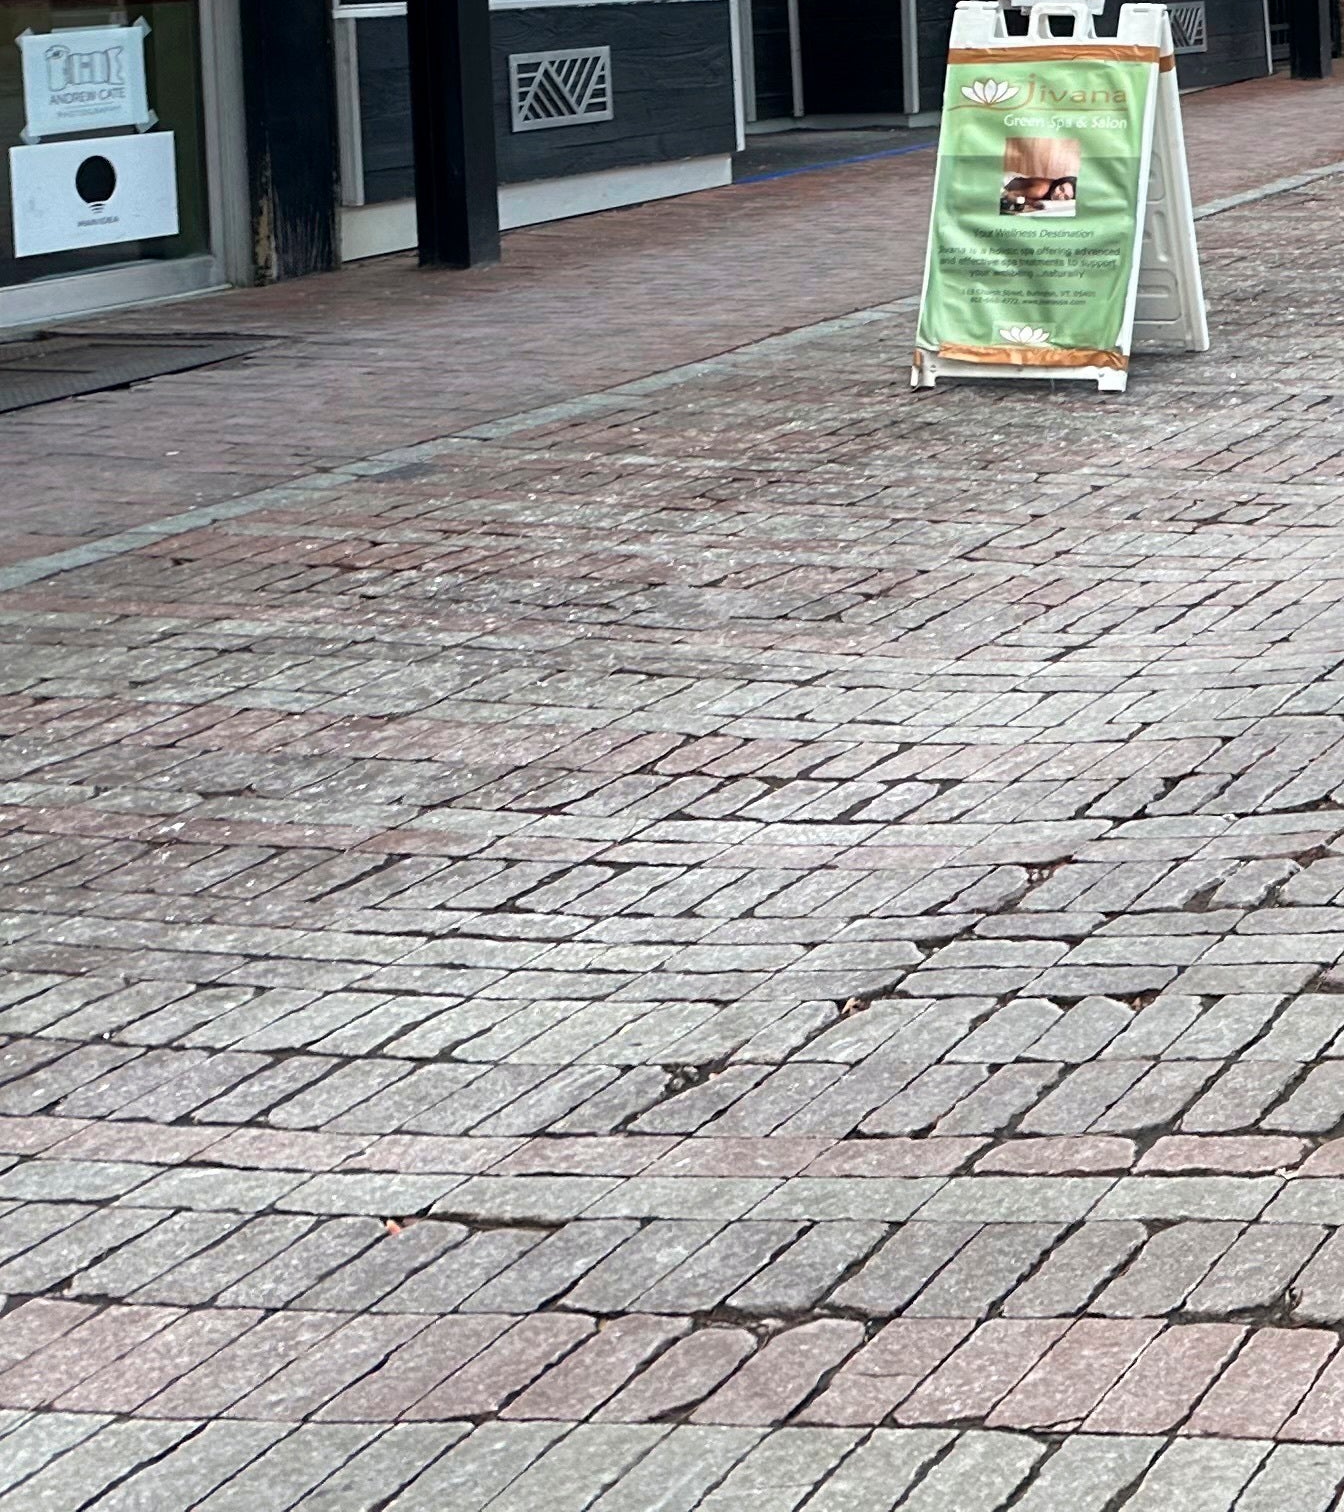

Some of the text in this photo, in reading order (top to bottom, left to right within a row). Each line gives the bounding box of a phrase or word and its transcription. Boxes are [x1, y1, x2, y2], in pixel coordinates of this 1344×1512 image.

[50, 87, 127, 106] ANDREW CATE
[1024, 73, 1127, 106] jivana
[1003, 113, 1128, 131] Green Spa & Salon
[1039, 228, 1094, 238] Destination
[1036, 246, 1072, 257] offering
